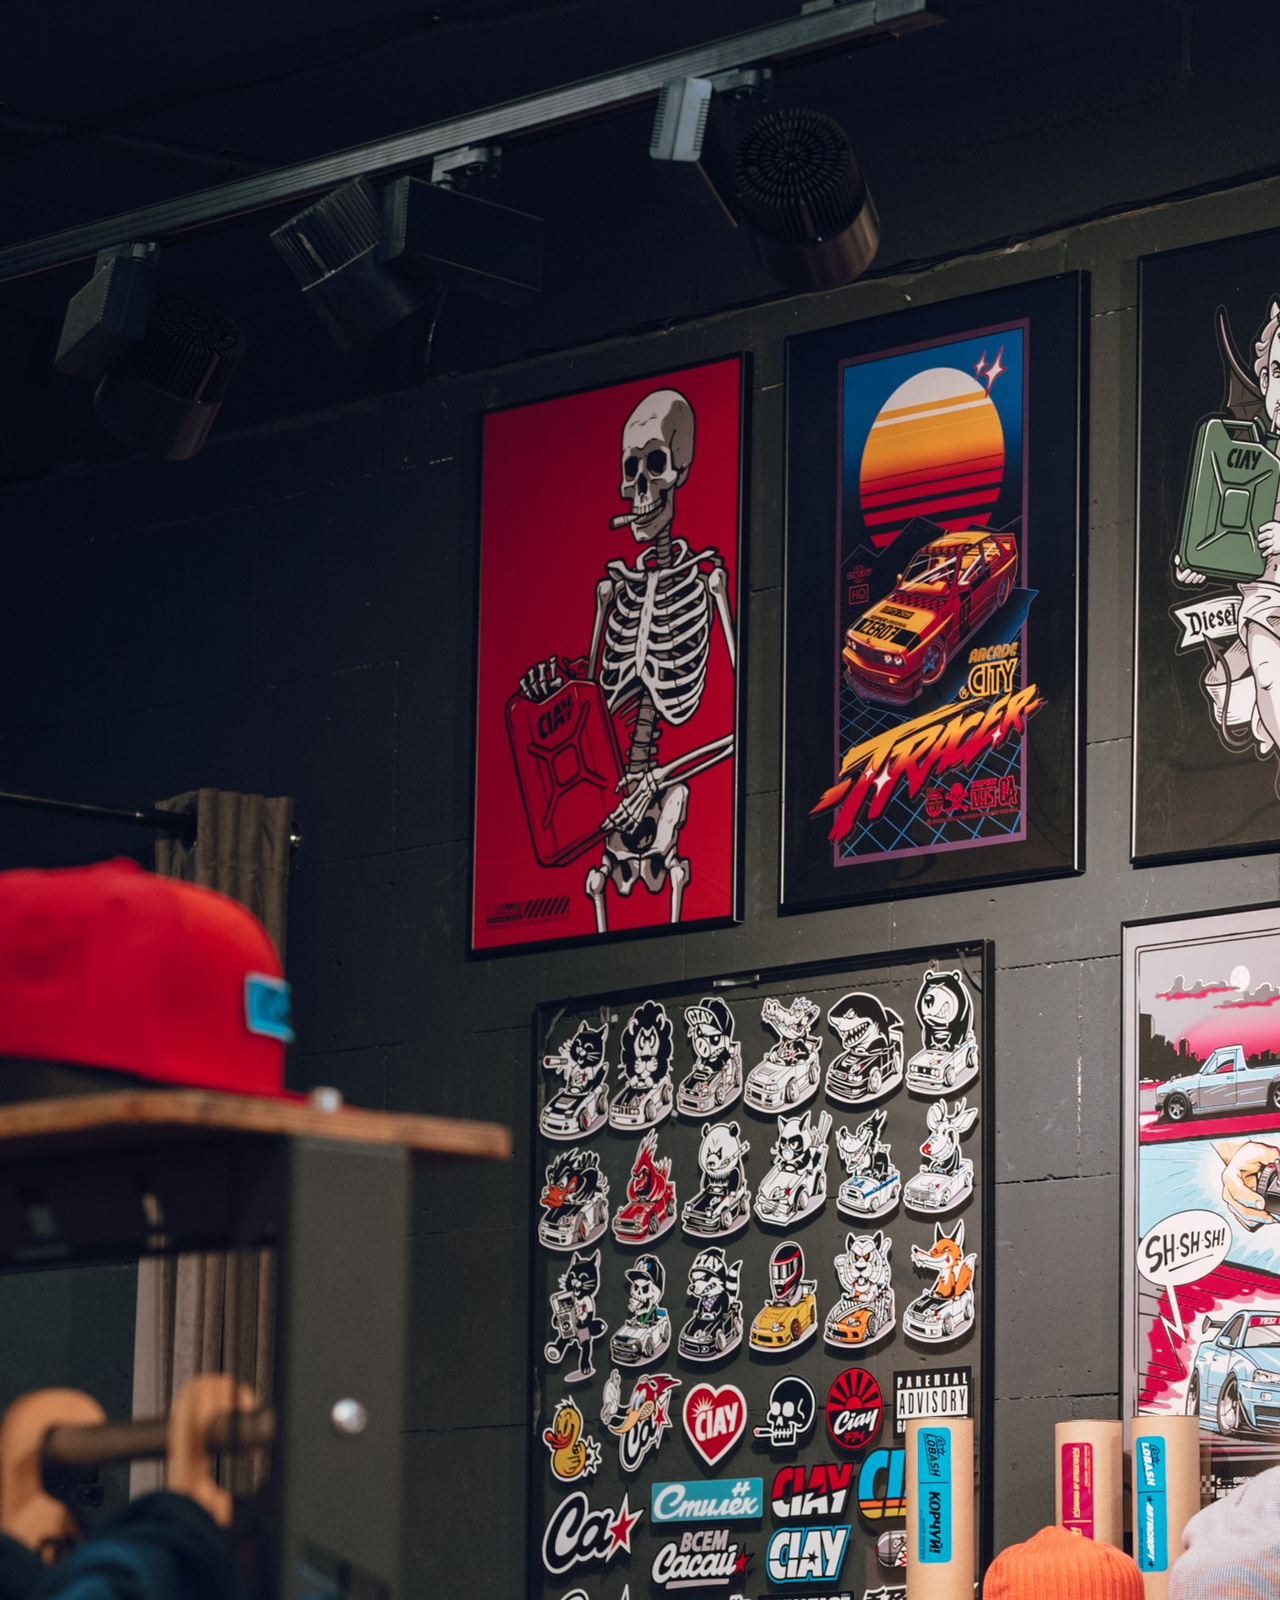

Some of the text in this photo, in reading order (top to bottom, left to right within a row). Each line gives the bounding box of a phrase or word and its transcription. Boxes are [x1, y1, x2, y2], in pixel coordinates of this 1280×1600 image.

[1185, 603, 1238, 637] Diesel
[968, 642, 1019, 663] ARCADE
[968, 657, 1019, 697] CITY
[809, 684, 1046, 843] TRACER
[1259, 1316, 1277, 1326] YES!
[896, 1372, 969, 1390] PARENTAL
[898, 1389, 968, 1415] ADVISORY
[925, 1433, 941, 1477] LOBASH
[1142, 1442, 1157, 1487] LOBASH
[928, 1490, 944, 1555] КОРЧУЙ!
[680, 1529, 729, 1554] ВСЕМ
[651, 1542, 740, 1585] Сасай
